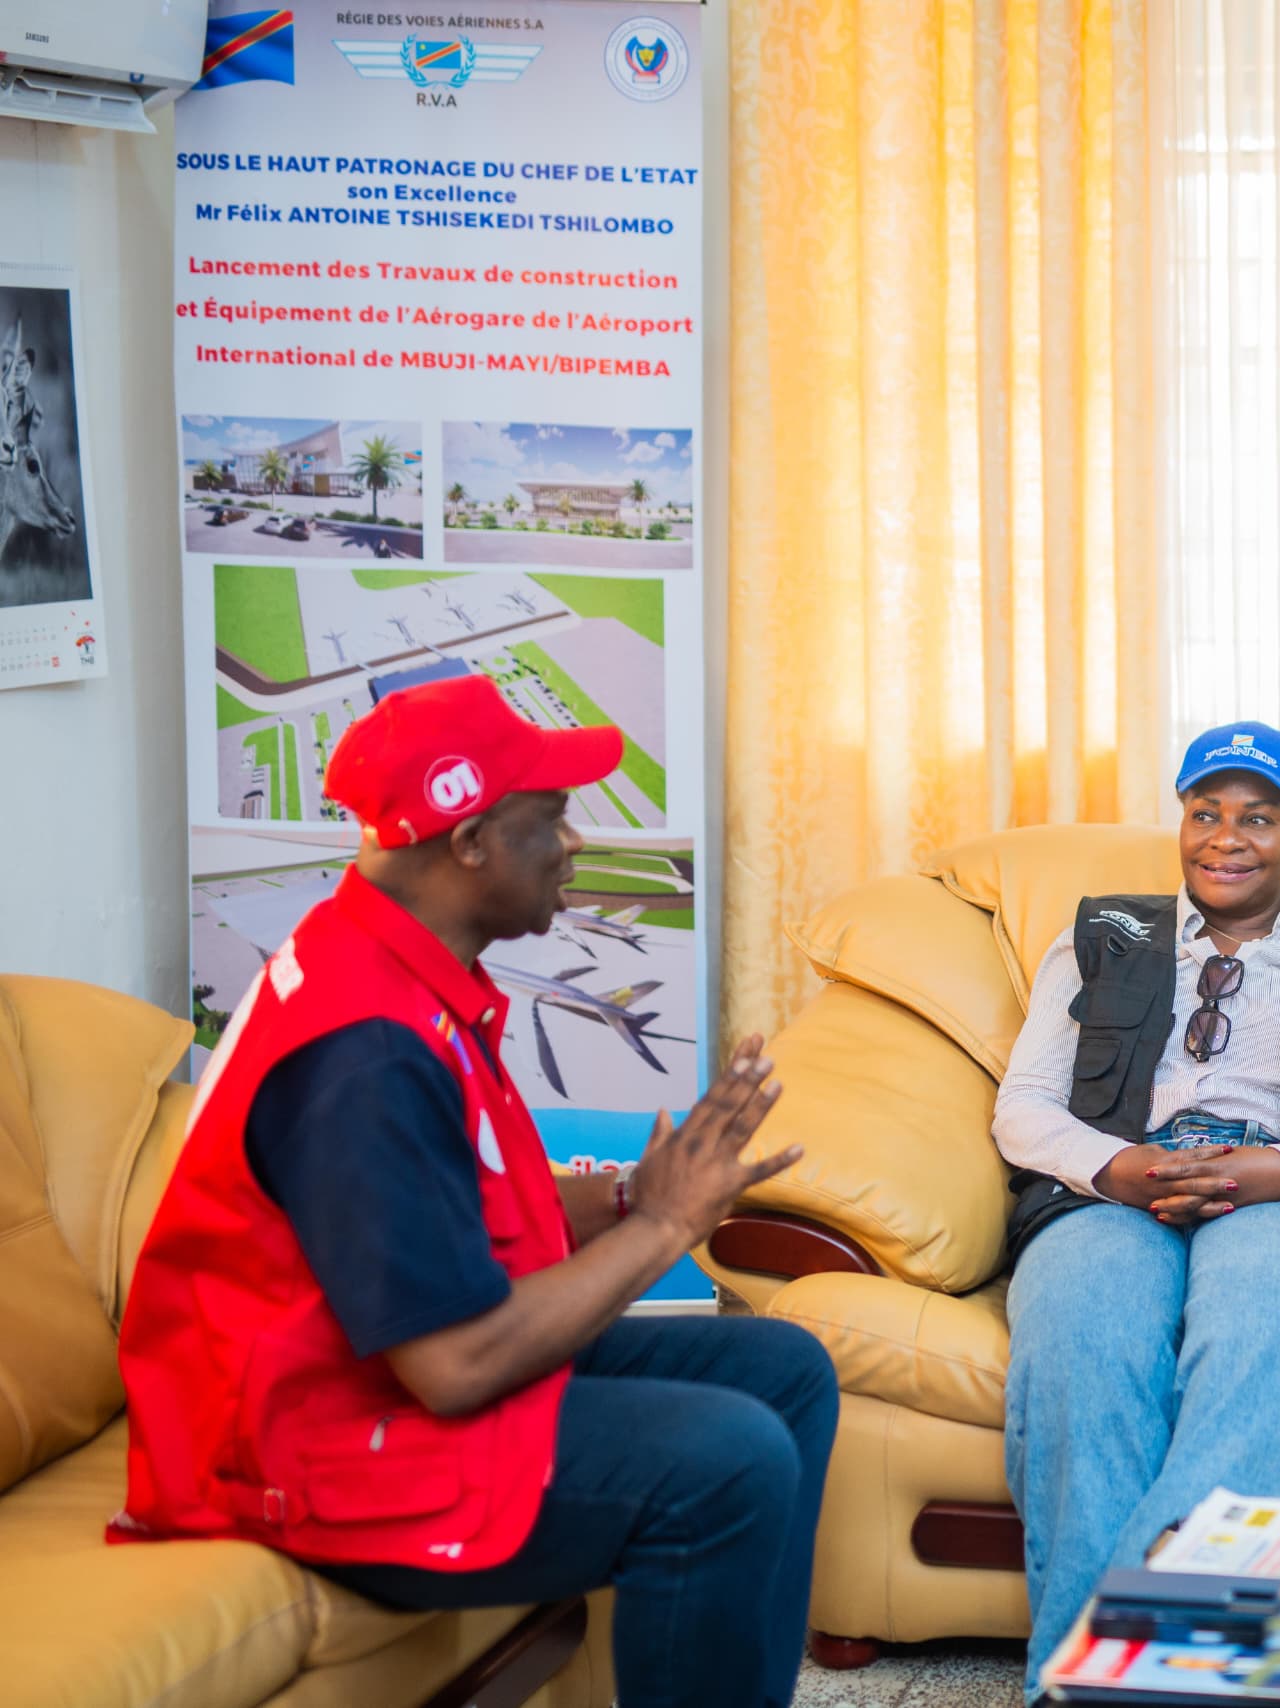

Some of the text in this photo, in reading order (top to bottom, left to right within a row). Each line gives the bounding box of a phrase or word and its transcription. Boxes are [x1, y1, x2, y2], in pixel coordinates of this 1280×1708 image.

[336, 10, 544, 30] RÉGIE DES VOIES AÉRIENNES S.A
[416, 92, 457, 108] R.V.A
[176, 152, 699, 185] SOUS LE HAUT PATRONAGE DU CHEF DE L'ETAT
[347, 184, 517, 204] son Excellence
[196, 204, 674, 235] Mr Félix ANTOINE TSHISEKEDI TSHILOMBO
[189, 256, 679, 290] Lancement des Travaux de construction
[176, 296, 694, 336] et Équipement de l'Aérogare de l'Aéroport
[196, 345, 671, 377] International de MBUJI-MAYI/BIPEMBA
[1203, 745, 1279, 768] FONER
